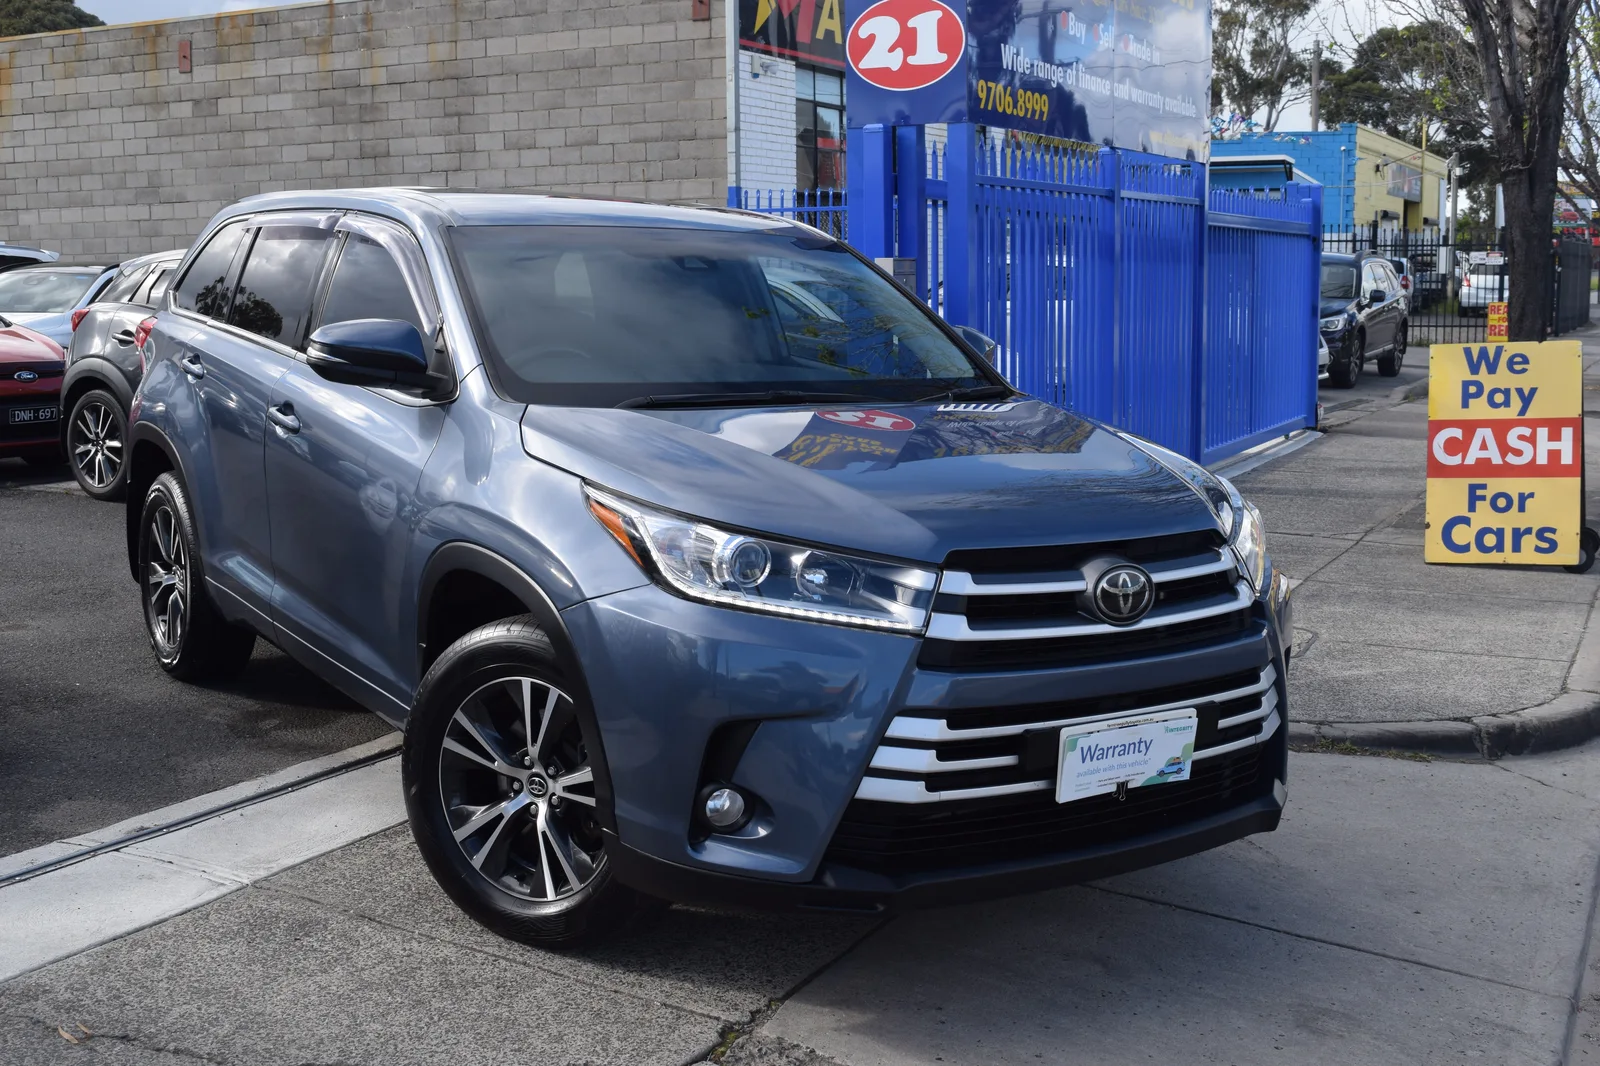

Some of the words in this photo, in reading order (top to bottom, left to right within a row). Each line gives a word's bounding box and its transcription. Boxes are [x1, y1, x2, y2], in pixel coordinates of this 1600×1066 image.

[858, 9, 948, 71] 21
[1068, 11, 1086, 44] Buy
[1099, 23, 1115, 48] Sell
[1129, 34, 1151, 61] Trade
[1152, 44, 1160, 65] in
[1001, 43, 1031, 74] Wide
[1034, 59, 1064, 88] range
[1066, 61, 1076, 85] of
[1078, 63, 1111, 95] finance
[1113, 77, 1129, 100] and
[1131, 86, 1164, 113] warranty
[1165, 92, 1197, 117] available
[977, 79, 1049, 121] 9706.8999
[1463, 345, 1530, 375] We
[1461, 380, 1538, 417] Pay
[1432, 426, 1573, 465] CASH
[1468, 483, 1535, 513] For
[1441, 515, 1559, 554] Cars
[1076, 765, 1102, 778] available
[1102, 763, 1115, 772] with
[1116, 760, 1128, 770] this
[1080, 737, 1153, 764] Warranty
